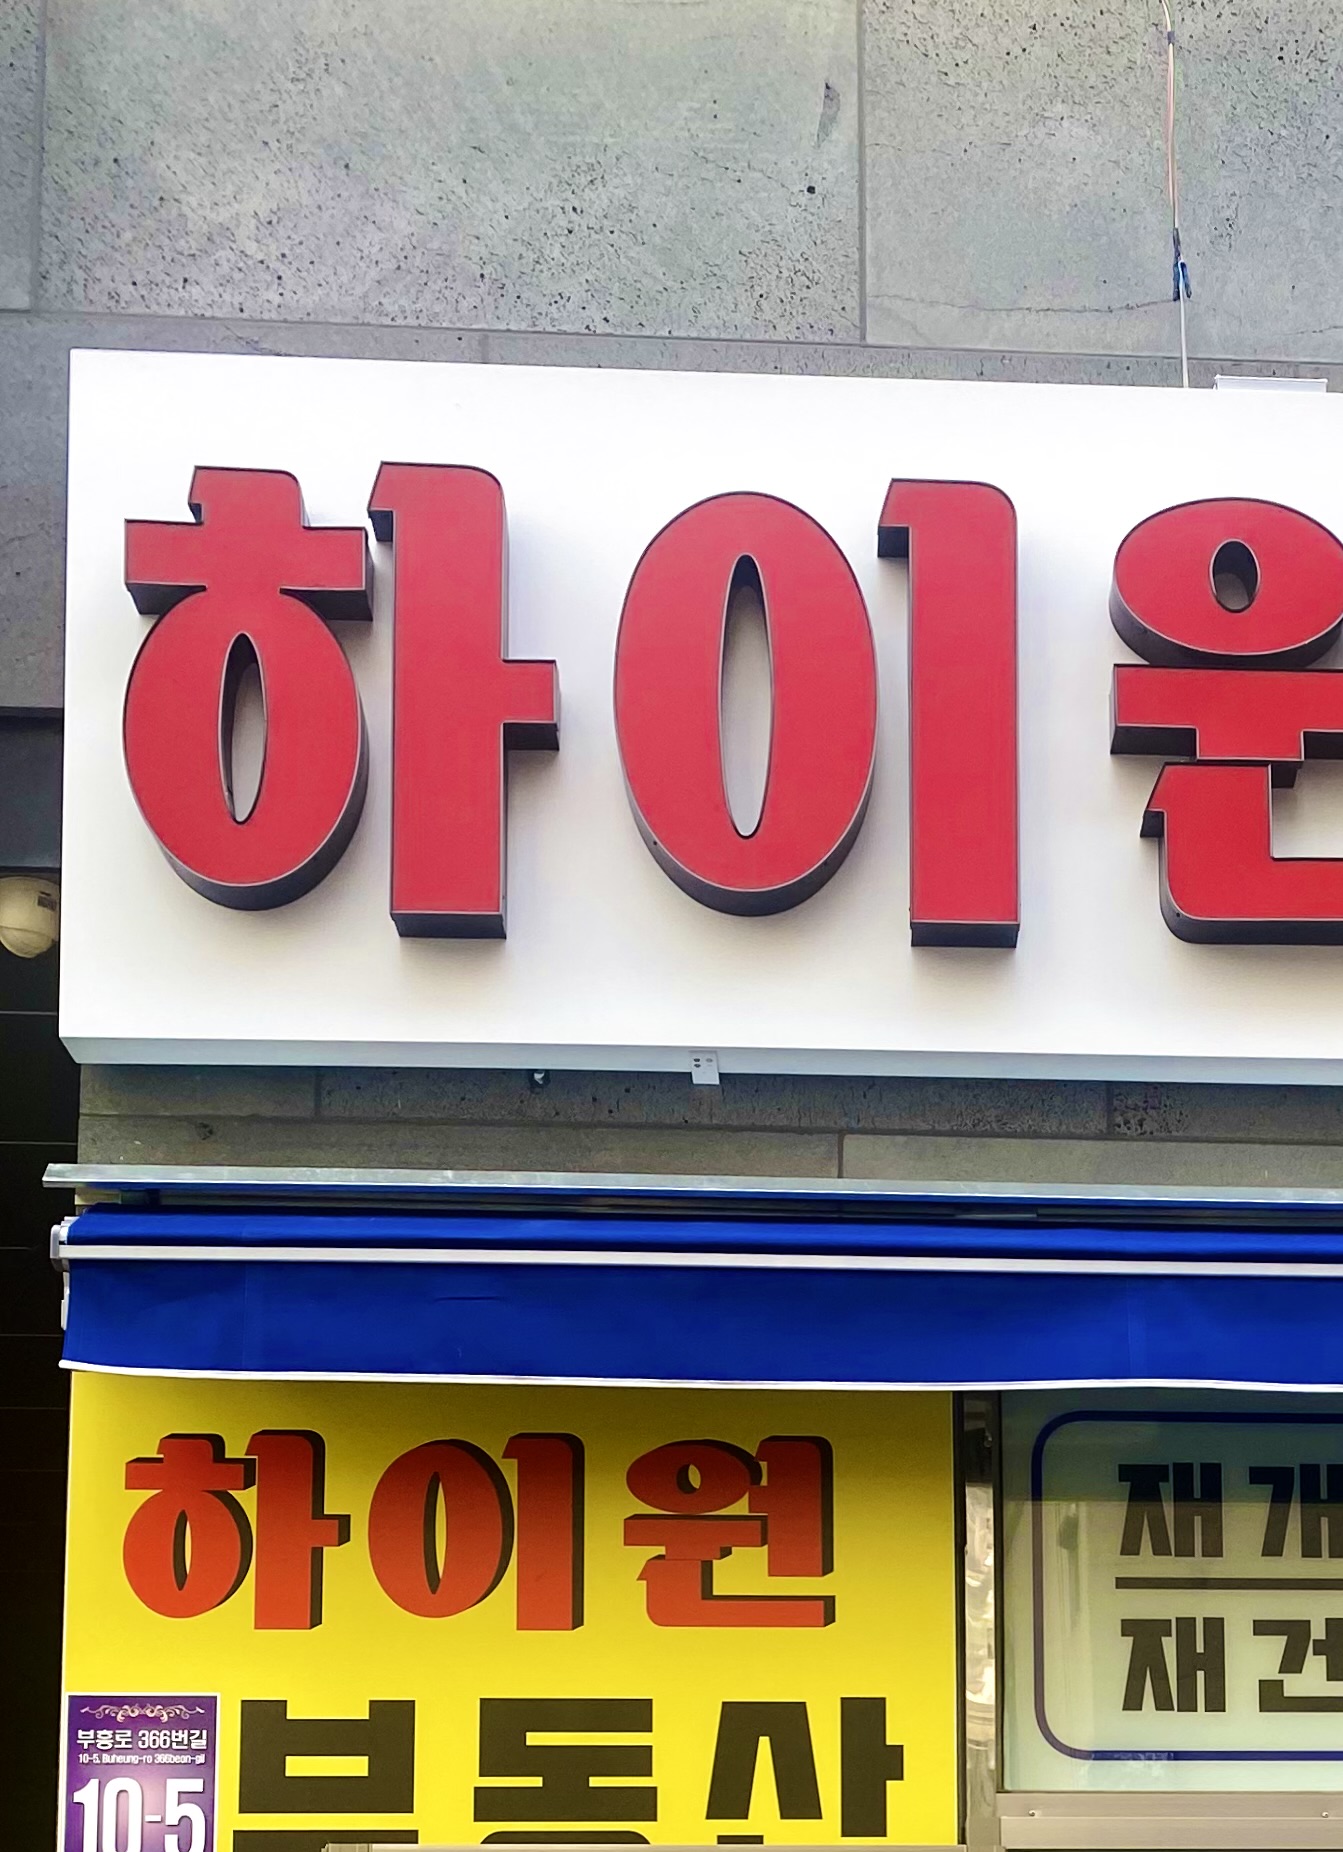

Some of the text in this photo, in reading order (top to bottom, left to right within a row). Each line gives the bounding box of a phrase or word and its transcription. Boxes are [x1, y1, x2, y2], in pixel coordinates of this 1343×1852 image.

[122, 1430, 837, 1632] 하이원
[76, 1729, 208, 1750] 부흥로 366번길
